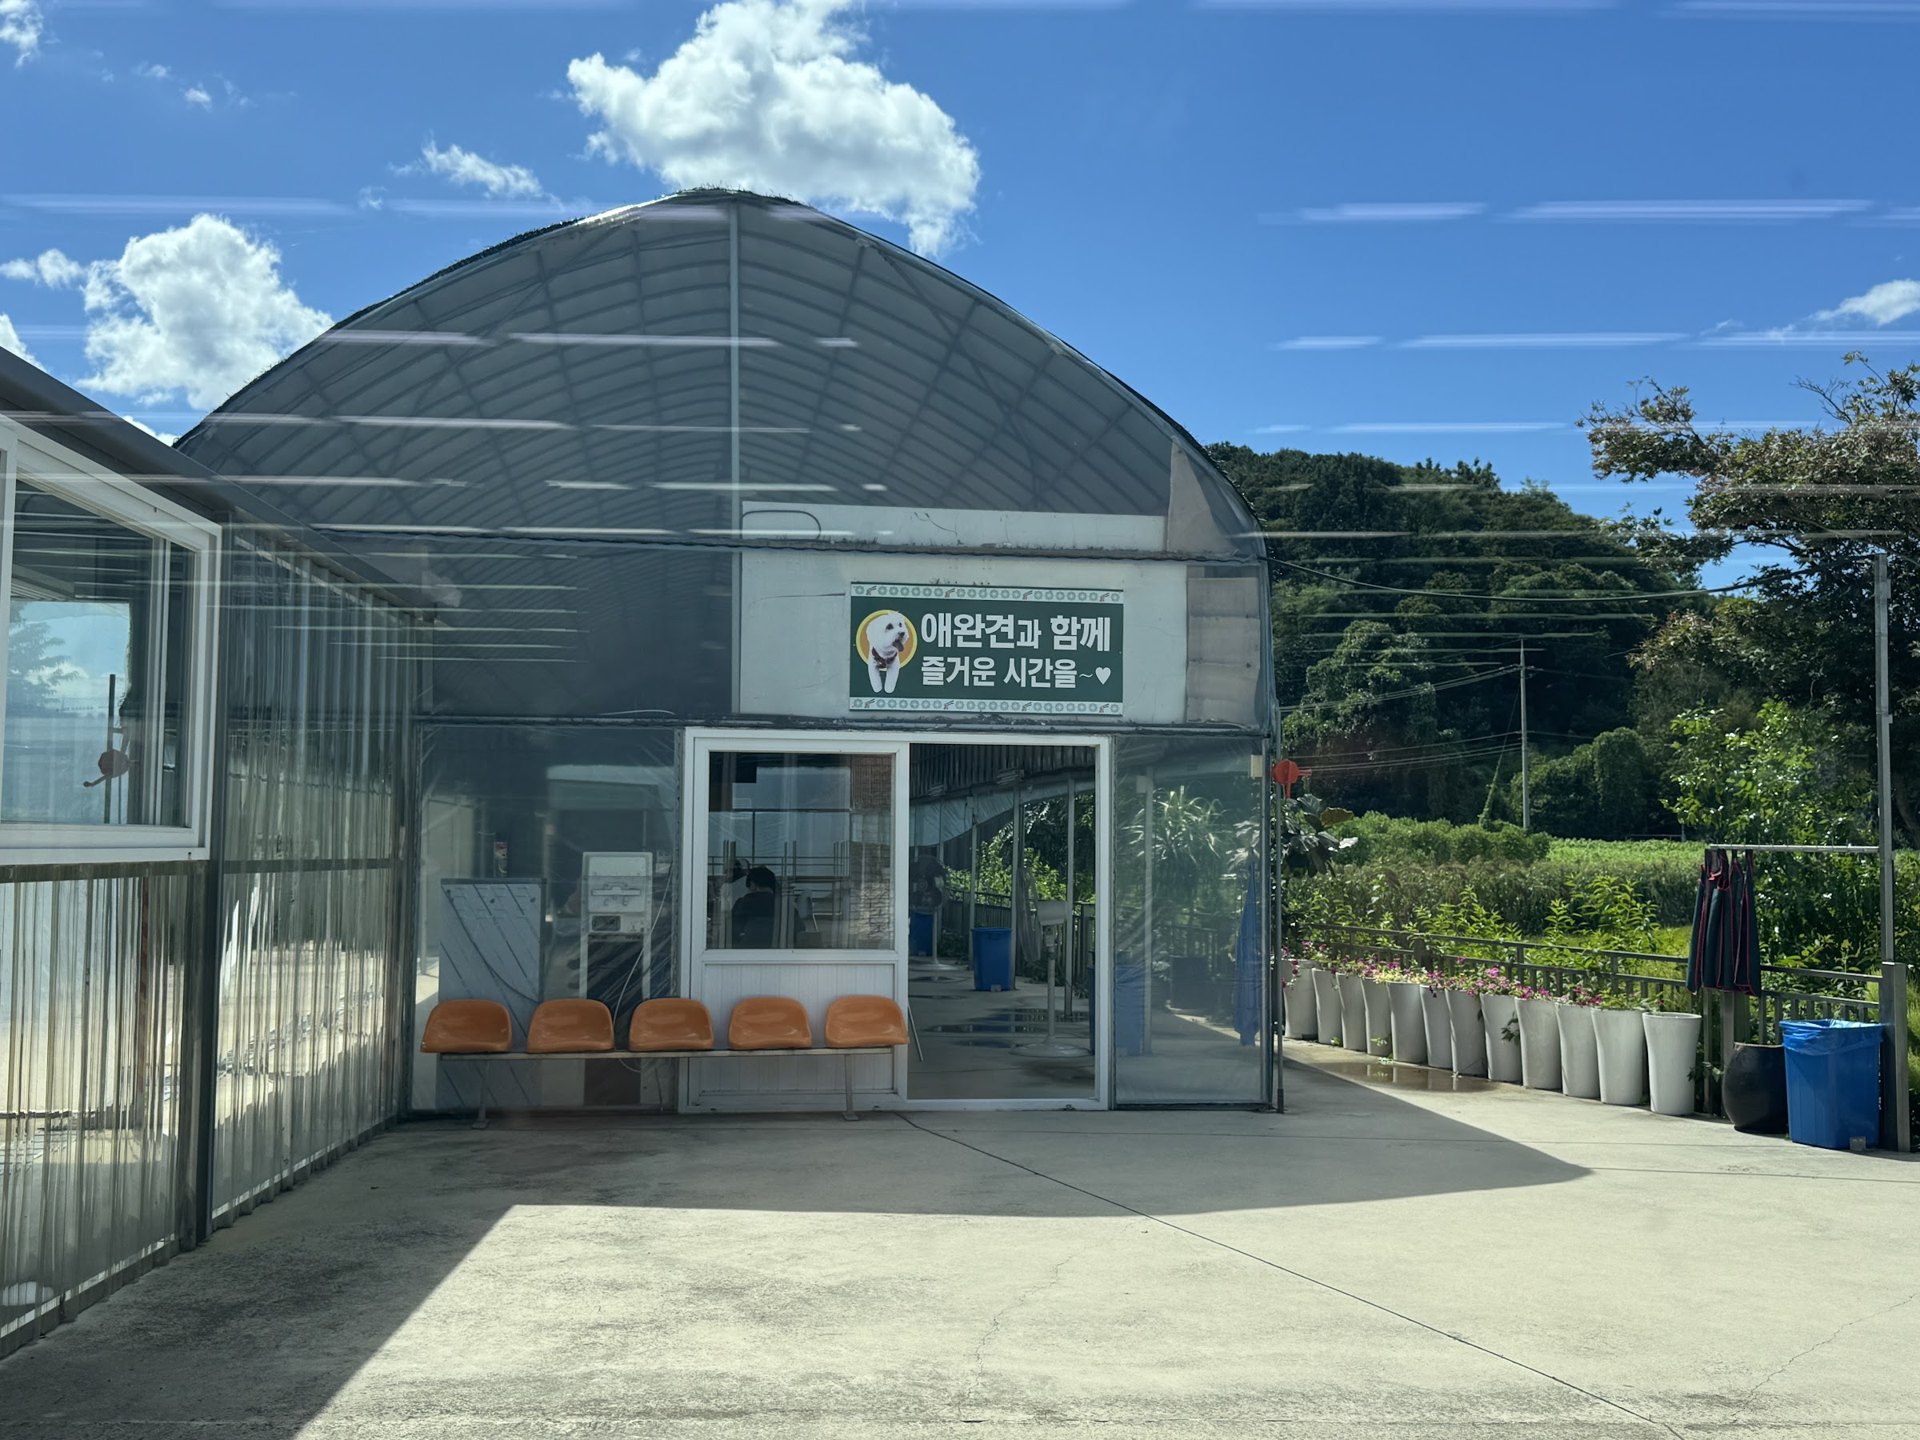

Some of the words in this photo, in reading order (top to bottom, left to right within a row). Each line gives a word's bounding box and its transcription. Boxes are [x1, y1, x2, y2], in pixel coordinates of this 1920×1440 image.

[921, 612, 1042, 649] 애완견과
[1050, 615, 1111, 652] 함께
[921, 656, 997, 687] 즐거운
